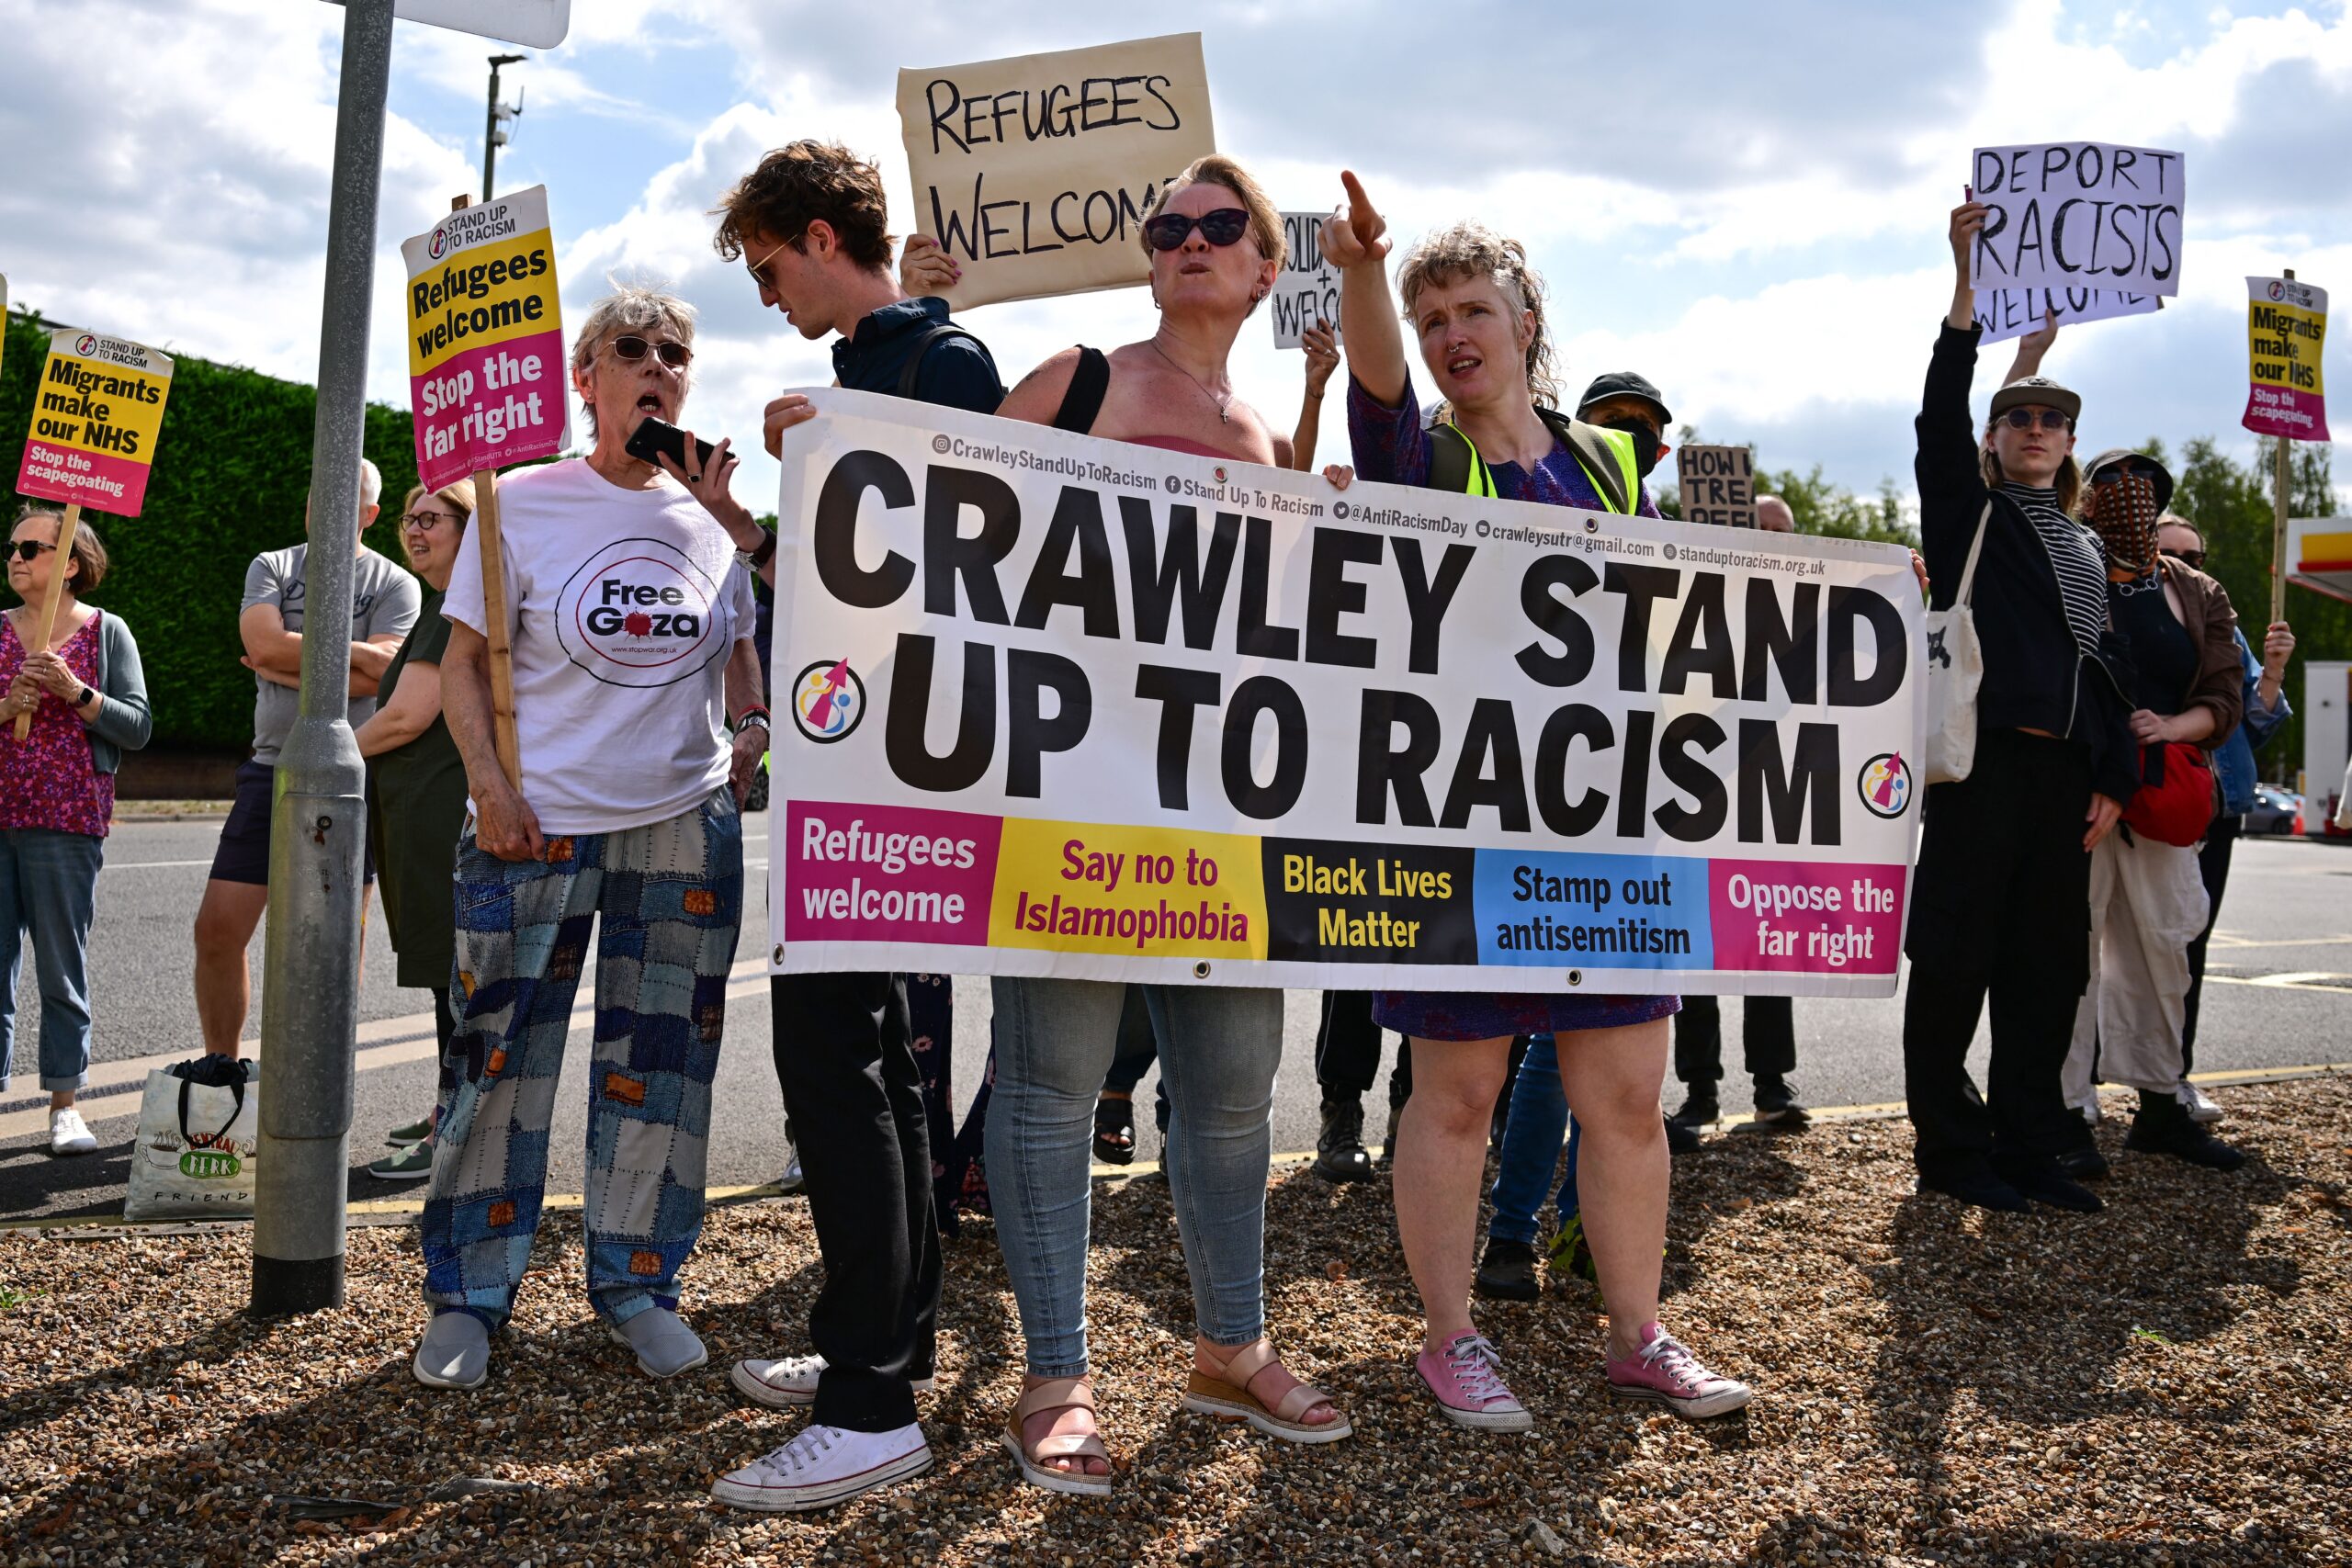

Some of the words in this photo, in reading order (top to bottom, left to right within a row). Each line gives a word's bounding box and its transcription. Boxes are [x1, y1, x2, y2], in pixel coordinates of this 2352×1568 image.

[926, 75, 1181, 154] REFUGEES
[1977, 145, 2177, 195] DEPORT
[448, 212, 485, 235] STAND
[490, 205, 507, 221] UP
[448, 233, 461, 250] TO
[466, 219, 515, 244] RACISM
[929, 172, 1179, 261] WELCOM
[1977, 198, 2177, 281] RACISTS
[413, 249, 548, 319] Refugees
[416, 294, 543, 359] welcome
[2254, 306, 2322, 341] Migrants
[98, 349, 109, 359] TO
[111, 352, 148, 367] RACISM
[99, 339, 129, 354] STAND
[130, 346, 145, 356] UP
[2254, 336, 2299, 359] make
[48, 358, 161, 404] Migrants
[422, 369, 474, 417] Stop
[482, 351, 542, 390] the
[2255, 362, 2286, 381] our
[42, 391, 110, 422] make
[2254, 389, 2278, 407] Stop
[37, 418, 79, 441] our
[83, 422, 140, 455] NHS
[424, 421, 458, 461] far
[462, 391, 544, 444] right
[27, 464, 125, 498] scapegoating
[30, 446, 63, 468] Stop
[66, 454, 92, 471] the
[1681, 449, 1735, 476] HOW
[953, 438, 1158, 491] CrawleyStandUpToRacism
[1183, 479, 1225, 502] Stand
[1230, 486, 1250, 508] Up
[1254, 490, 1266, 509] To
[1271, 493, 1324, 517] Racism
[1350, 504, 1468, 538] @AntiRacismDay
[1492, 526, 1655, 557] crawleysutr@gmail.com
[1679, 547, 1826, 576] standuptoracism.org.uk
[602, 579, 684, 605] Free
[814, 449, 1476, 674] CRAWLEY
[1514, 554, 1907, 707] STAND
[885, 632, 1092, 798] UP
[1135, 663, 1308, 819] TO
[1356, 688, 1841, 846] RACISM
[802, 817, 977, 874] Refugees
[1060, 839, 1125, 891] Say
[1135, 853, 1174, 882] no
[1186, 848, 1218, 886] to
[1283, 853, 1367, 897] Black
[1377, 859, 1453, 899] Lives
[1512, 865, 1611, 913] Stamp
[1623, 872, 1671, 907] out
[1728, 874, 1842, 918] Oppose
[1851, 878, 1894, 913] the
[802, 877, 965, 924] welcome
[1014, 891, 1249, 948] Islamophobia
[1318, 908, 1420, 948] Matter
[1497, 914, 1690, 954] antisemitism
[1757, 920, 1799, 956] far
[1808, 922, 1874, 967] right
[189, 1155, 232, 1176] PERK
